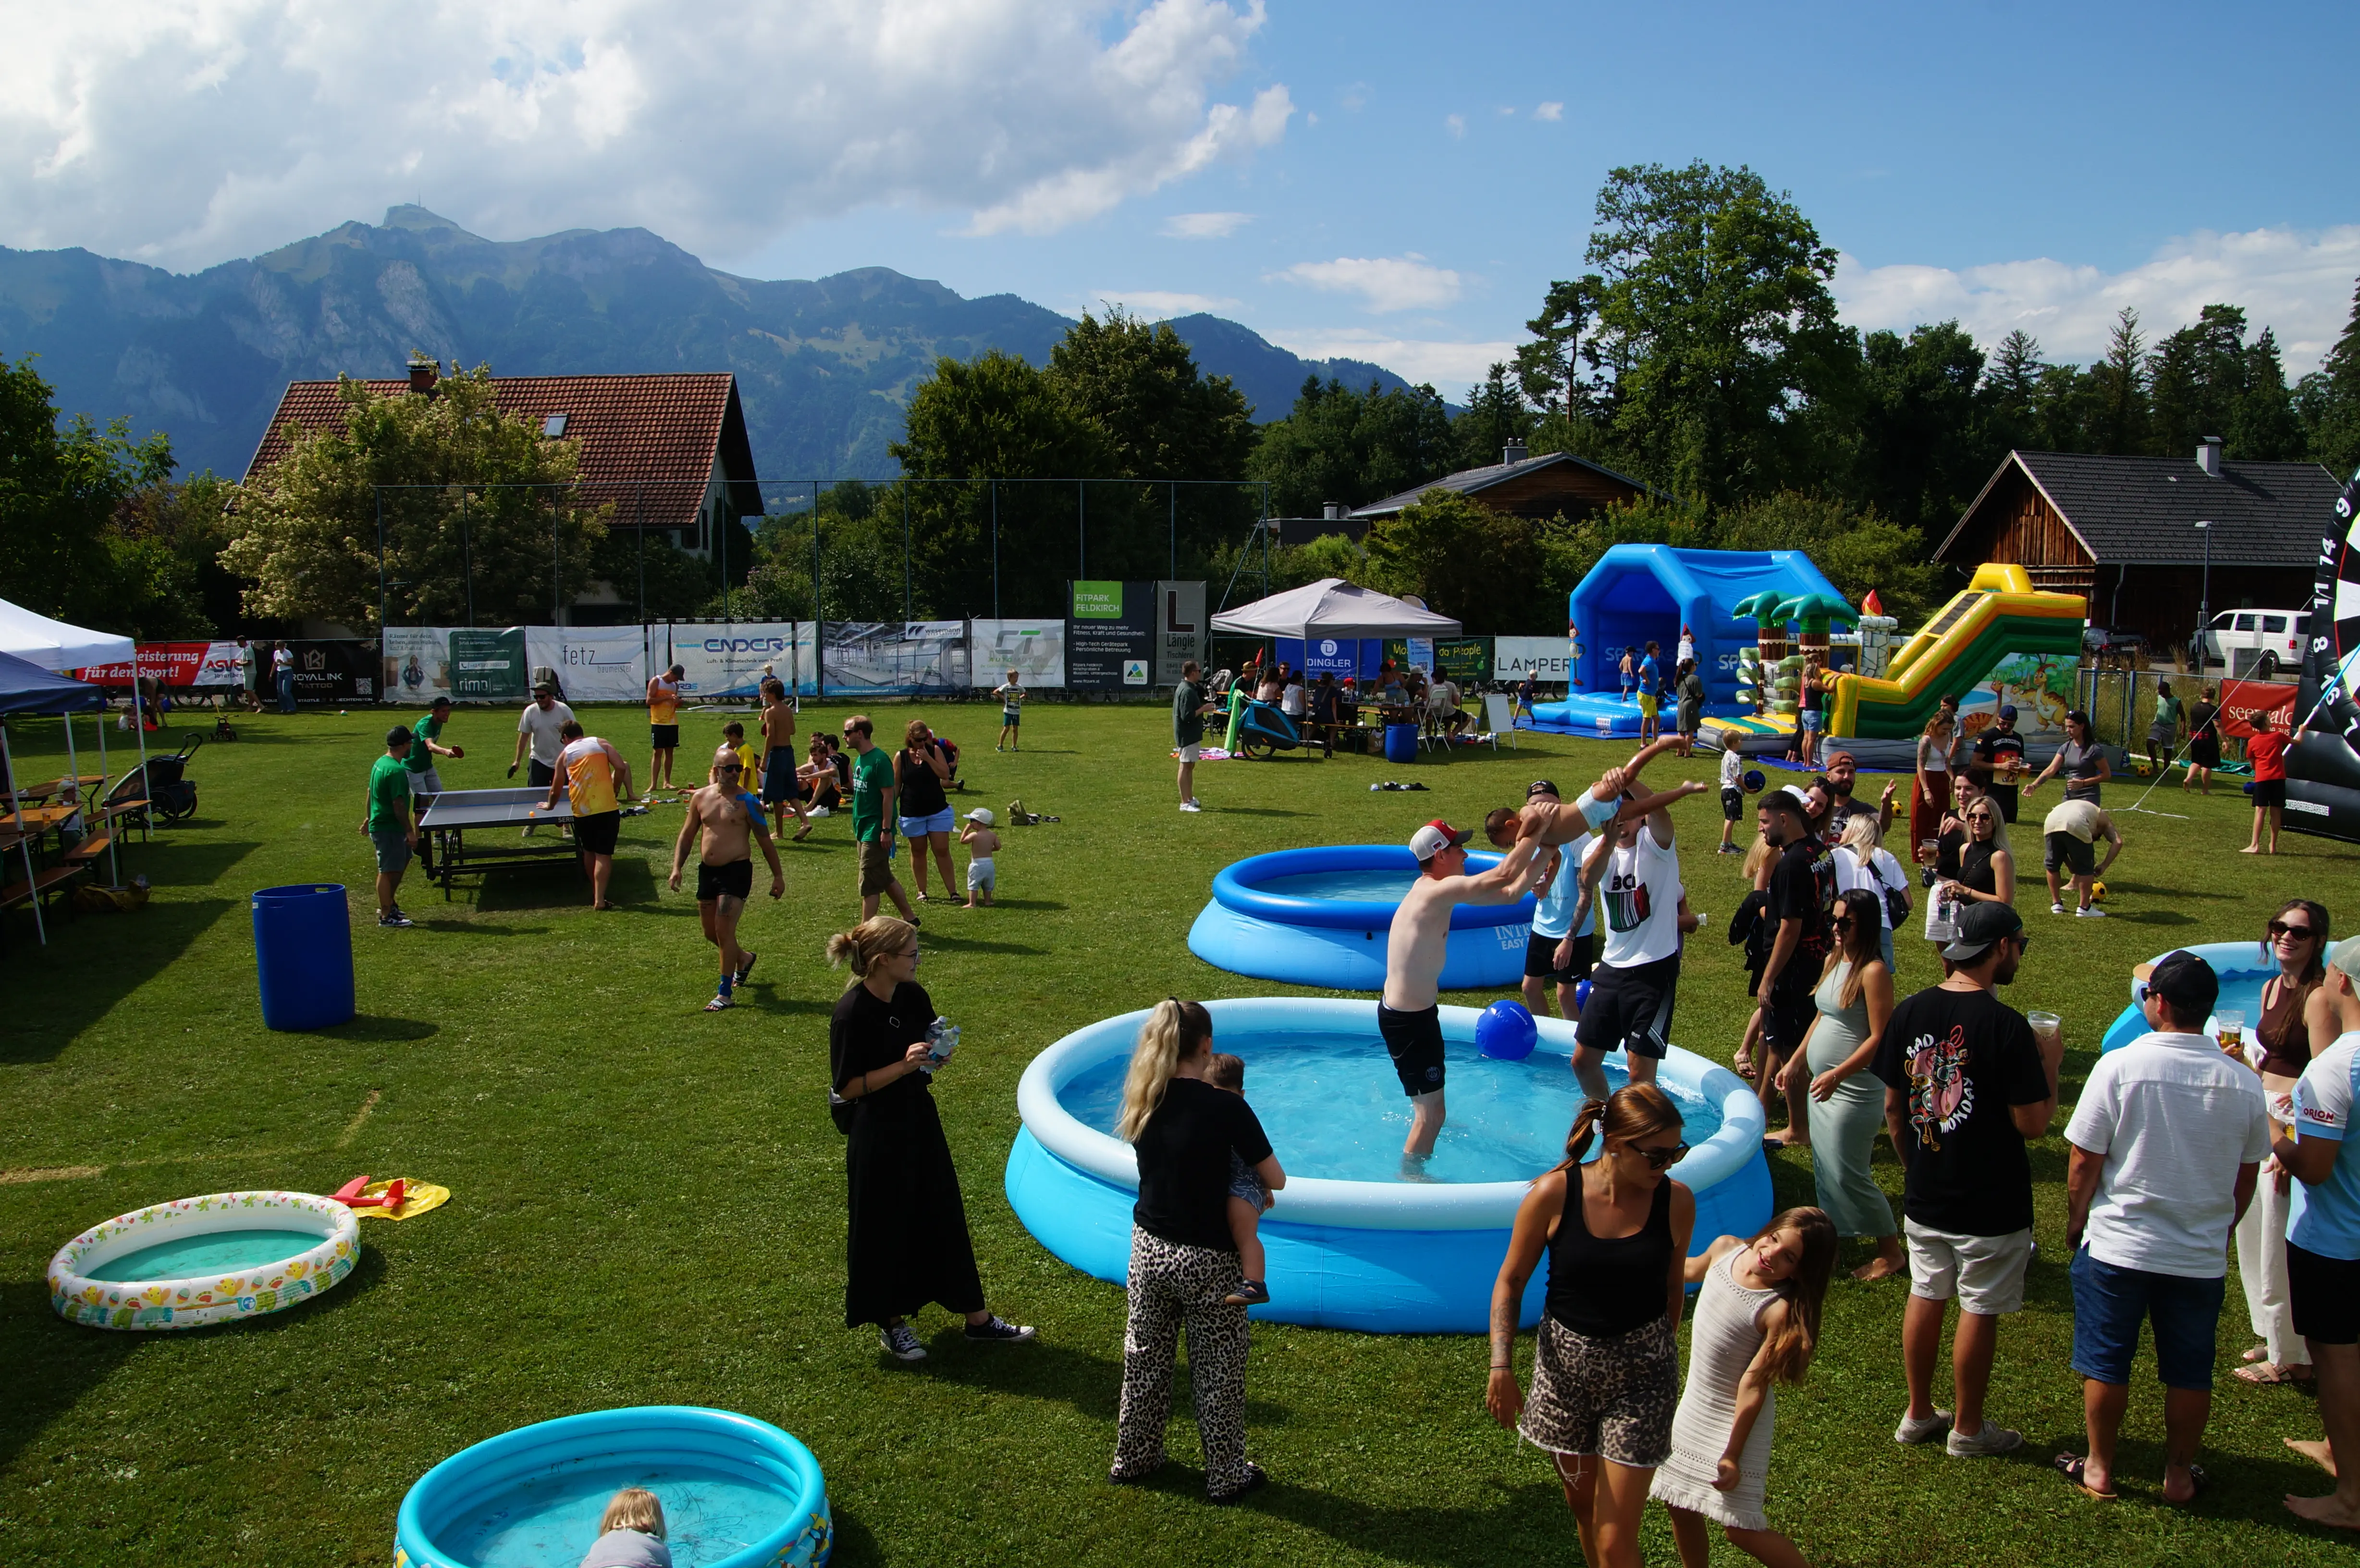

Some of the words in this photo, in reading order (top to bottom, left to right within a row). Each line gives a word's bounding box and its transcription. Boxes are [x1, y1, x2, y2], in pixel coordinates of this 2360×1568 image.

[2320, 538, 2336, 565] 14
[1076, 594, 1109, 602] FITPARK
[2314, 582, 2329, 609] 11
[1076, 604, 1119, 612] FELDKIRCH
[704, 637, 784, 652] ENDER
[1167, 633, 1195, 650] Längle
[1393, 643, 1408, 655] Mo
[2313, 636, 2328, 653] 8
[133, 649, 199, 665] eisterung
[563, 645, 595, 665] fetz
[1307, 658, 1351, 667] DINGLER
[82, 666, 108, 681] für
[110, 666, 135, 678] den
[138, 665, 180, 678] Sport!
[292, 673, 325, 681] ROYAL
[327, 673, 343, 681] INK
[597, 665, 632, 673] baumeister
[459, 678, 488, 691] rimo
[2320, 674, 2340, 706] 16
[2344, 716, 2358, 737] 7
[1501, 938, 1524, 950] EASY
[1906, 1033, 1934, 1059] BAD
[1939, 1077, 1975, 1134] MONDAY
[2303, 1107, 2335, 1124] ORION
